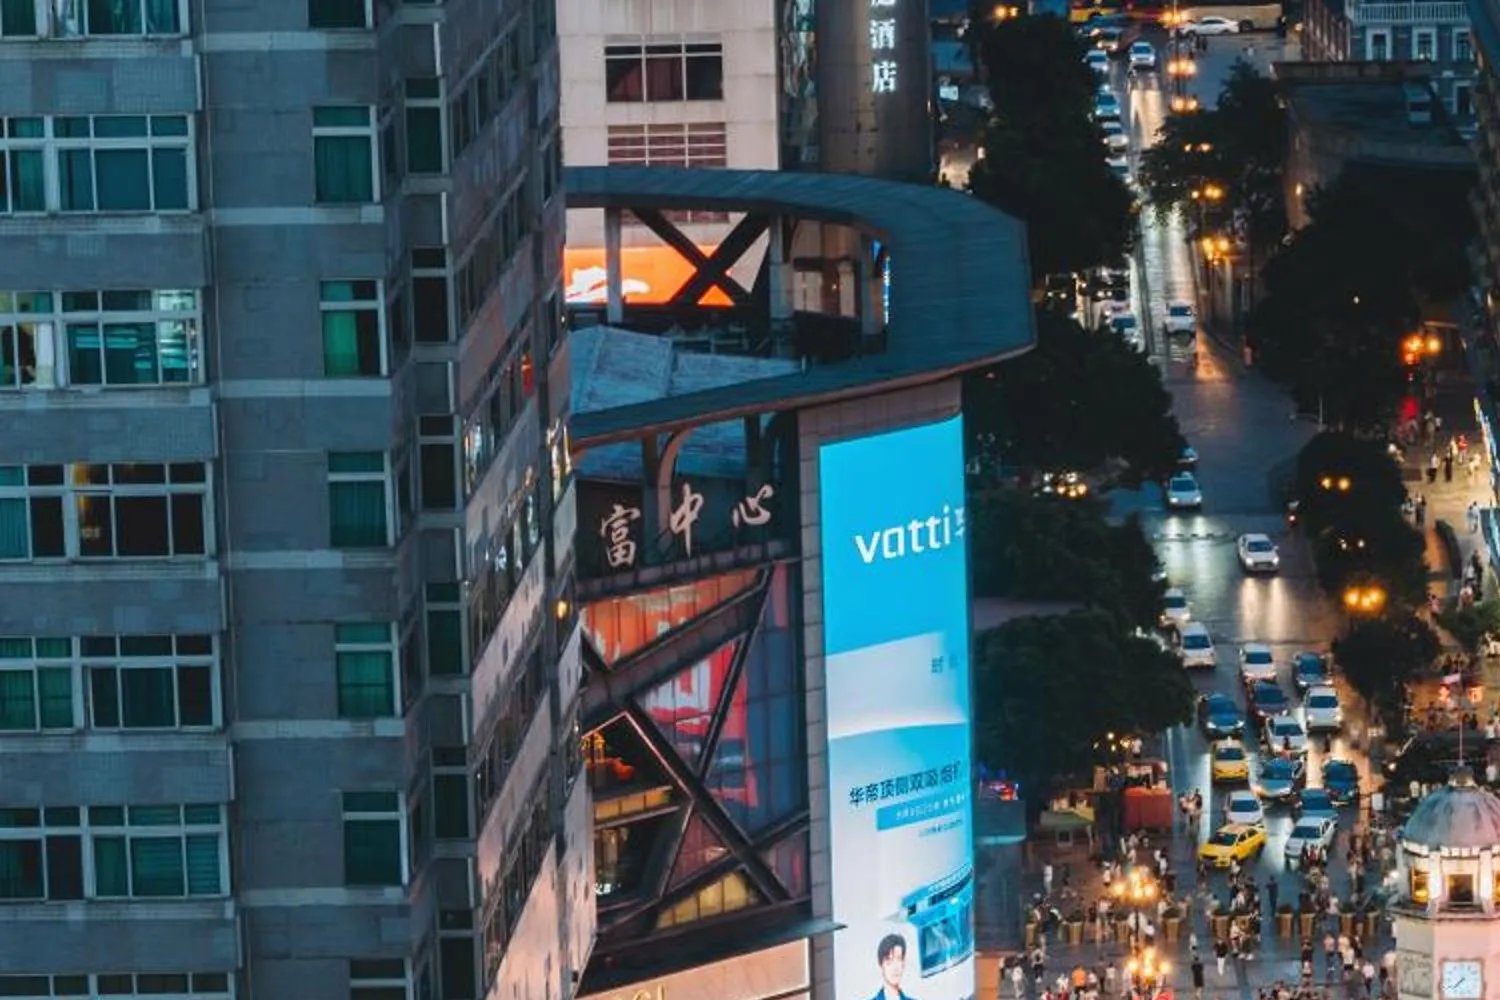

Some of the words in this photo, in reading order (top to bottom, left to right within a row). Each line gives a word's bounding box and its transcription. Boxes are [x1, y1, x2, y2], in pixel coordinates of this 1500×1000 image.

[869, 0, 897, 93] 酒店
[600, 482, 774, 568] 富中心
[855, 505, 951, 564] vatti
